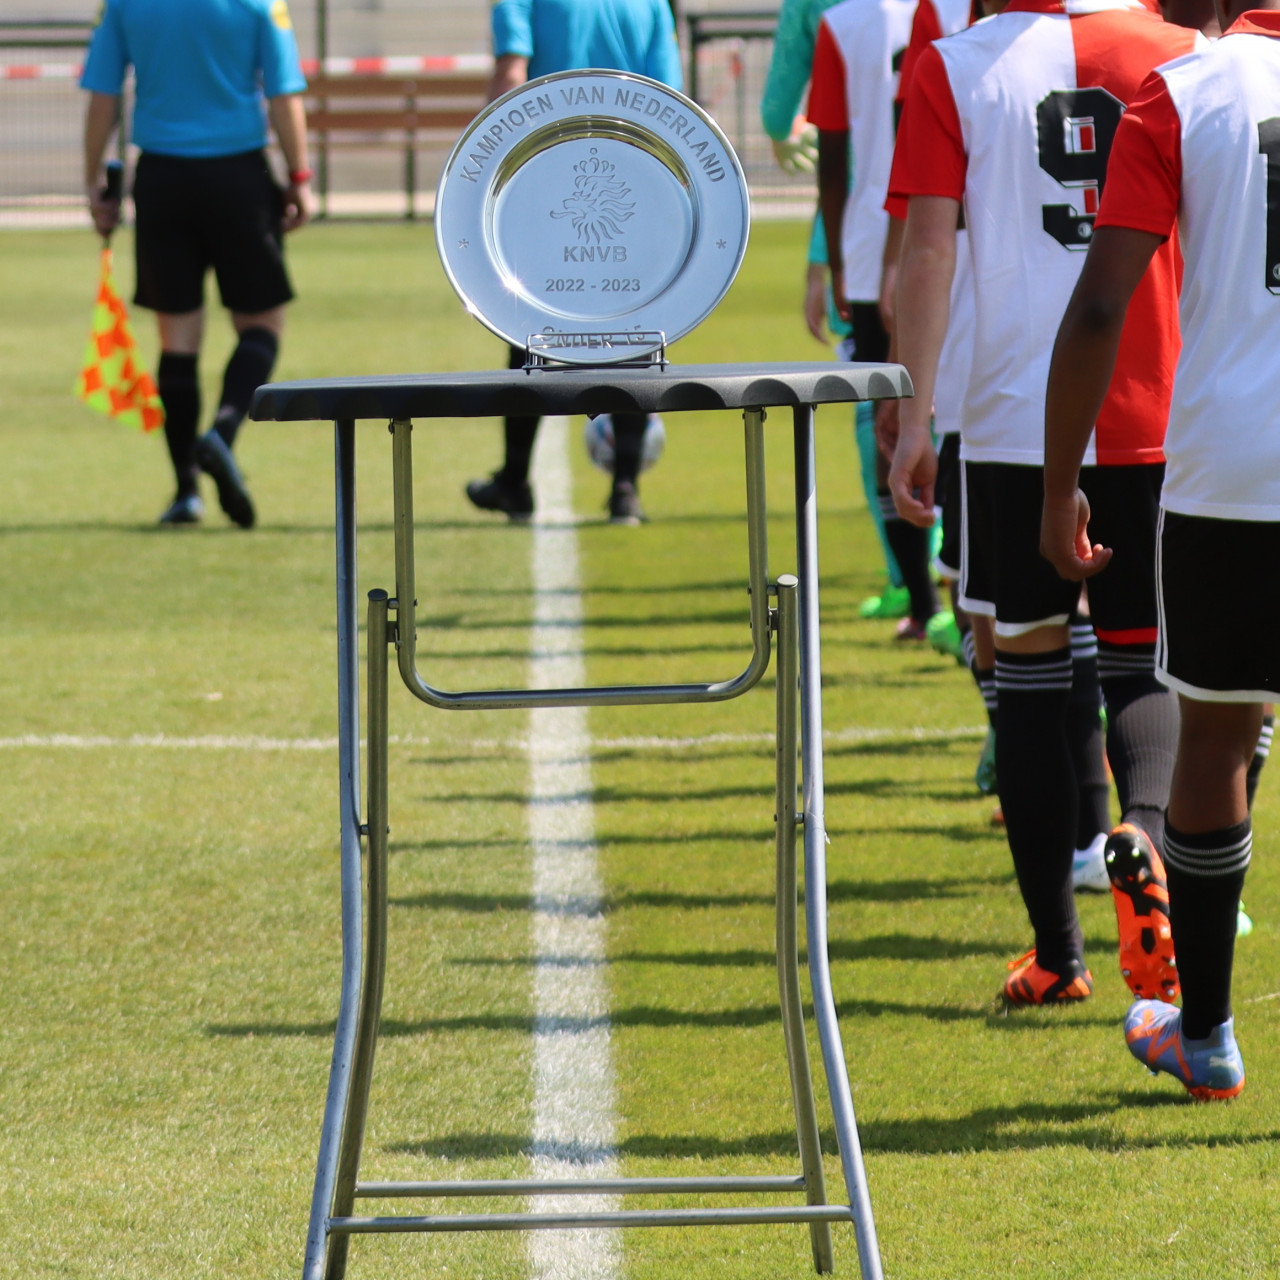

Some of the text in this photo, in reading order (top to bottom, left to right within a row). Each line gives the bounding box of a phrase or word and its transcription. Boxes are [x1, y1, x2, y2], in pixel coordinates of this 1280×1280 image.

[460, 86, 726, 184] KAMPIOEN VAN NEDERLAND
[1036, 86, 1128, 252] 9
[563, 246, 627, 263] KNVB
[545, 279, 585, 292] 2022
[601, 279, 641, 292] 2023
[541, 325, 615, 350] ONDER
